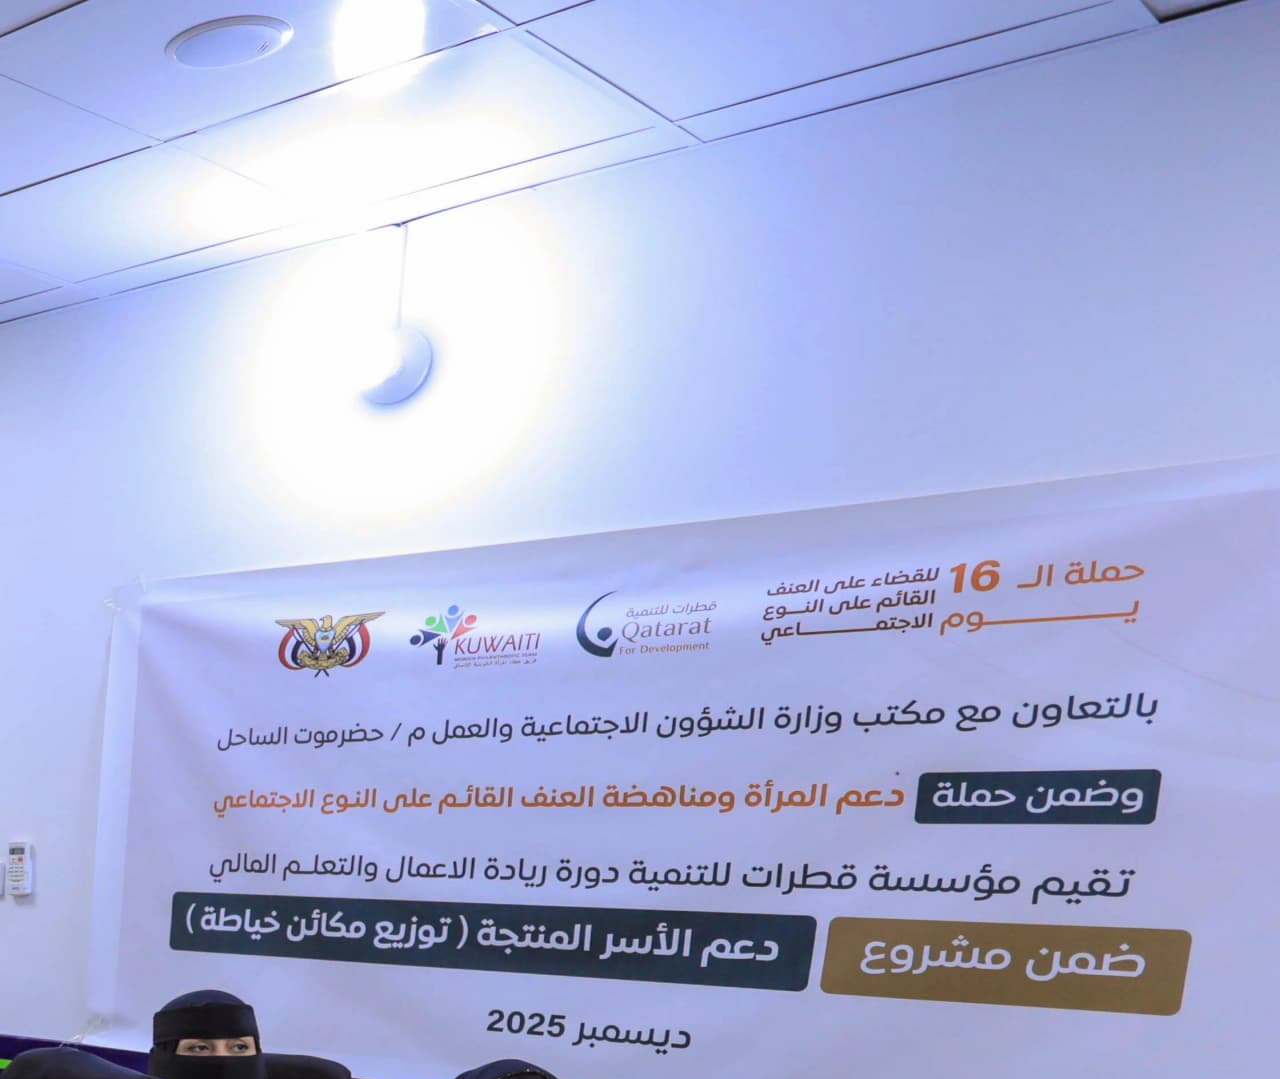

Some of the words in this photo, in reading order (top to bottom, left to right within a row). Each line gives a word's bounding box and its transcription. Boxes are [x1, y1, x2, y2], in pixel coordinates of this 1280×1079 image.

[824, 575, 866, 594] على
[871, 567, 940, 587] للقضاء
[950, 560, 1000, 593] 16
[1064, 560, 1145, 585] حملة
[767, 579, 820, 596] العنف
[876, 589, 936, 613] القائم
[626, 604, 669, 619] للتنمية
[672, 601, 717, 615] قطرات
[829, 595, 871, 615] على
[454, 632, 541, 655] KUWAITI
[622, 617, 712, 643] Qatarat
[619, 646, 636, 655] For
[640, 642, 710, 654] Development
[657, 706, 764, 739] الشؤون
[773, 705, 842, 734] وزارة
[853, 700, 946, 733] مكتب
[955, 704, 1001, 731] مع
[1012, 692, 1159, 729] بالتعاون
[216, 726, 288, 752] الساحل
[293, 724, 384, 749] حضرموت
[432, 718, 513, 745] والعمل
[521, 711, 648, 742] الاجتماعية
[213, 789, 315, 818] الاجتماعي
[320, 788, 377, 814] النوع
[383, 788, 432, 813] على
[438, 785, 513, 814] القائم
[521, 786, 594, 809] العنف
[602, 783, 736, 813] ومناهضة
[744, 779, 828, 813] المرأة
[835, 786, 905, 814] دعم
[932, 781, 1017, 809] حملة
[1025, 779, 1145, 814] وضمن
[209, 853, 276, 882] المالي
[282, 854, 378, 882] والتعلم
[386, 855, 475, 883] الاعمال
[483, 856, 547, 888] ريادة
[556, 858, 620, 890] دورة
[628, 861, 732, 892] للتنمية
[742, 863, 857, 895] قطرات
[869, 864, 1020, 901] مؤسسة
[1032, 868, 1135, 905] تقيم
[200, 906, 281, 940] خياطة
[287, 907, 366, 942] مكائن
[373, 915, 452, 950] توزيع
[477, 919, 592, 953] المنتجة
[599, 921, 692, 960] الأسر
[700, 938, 779, 967] دعم
[859, 934, 1012, 975] مشروع
[1025, 942, 1146, 982] ضمن
[486, 1009, 566, 1037] 2025
[571, 1022, 692, 1055] ديسمبر
